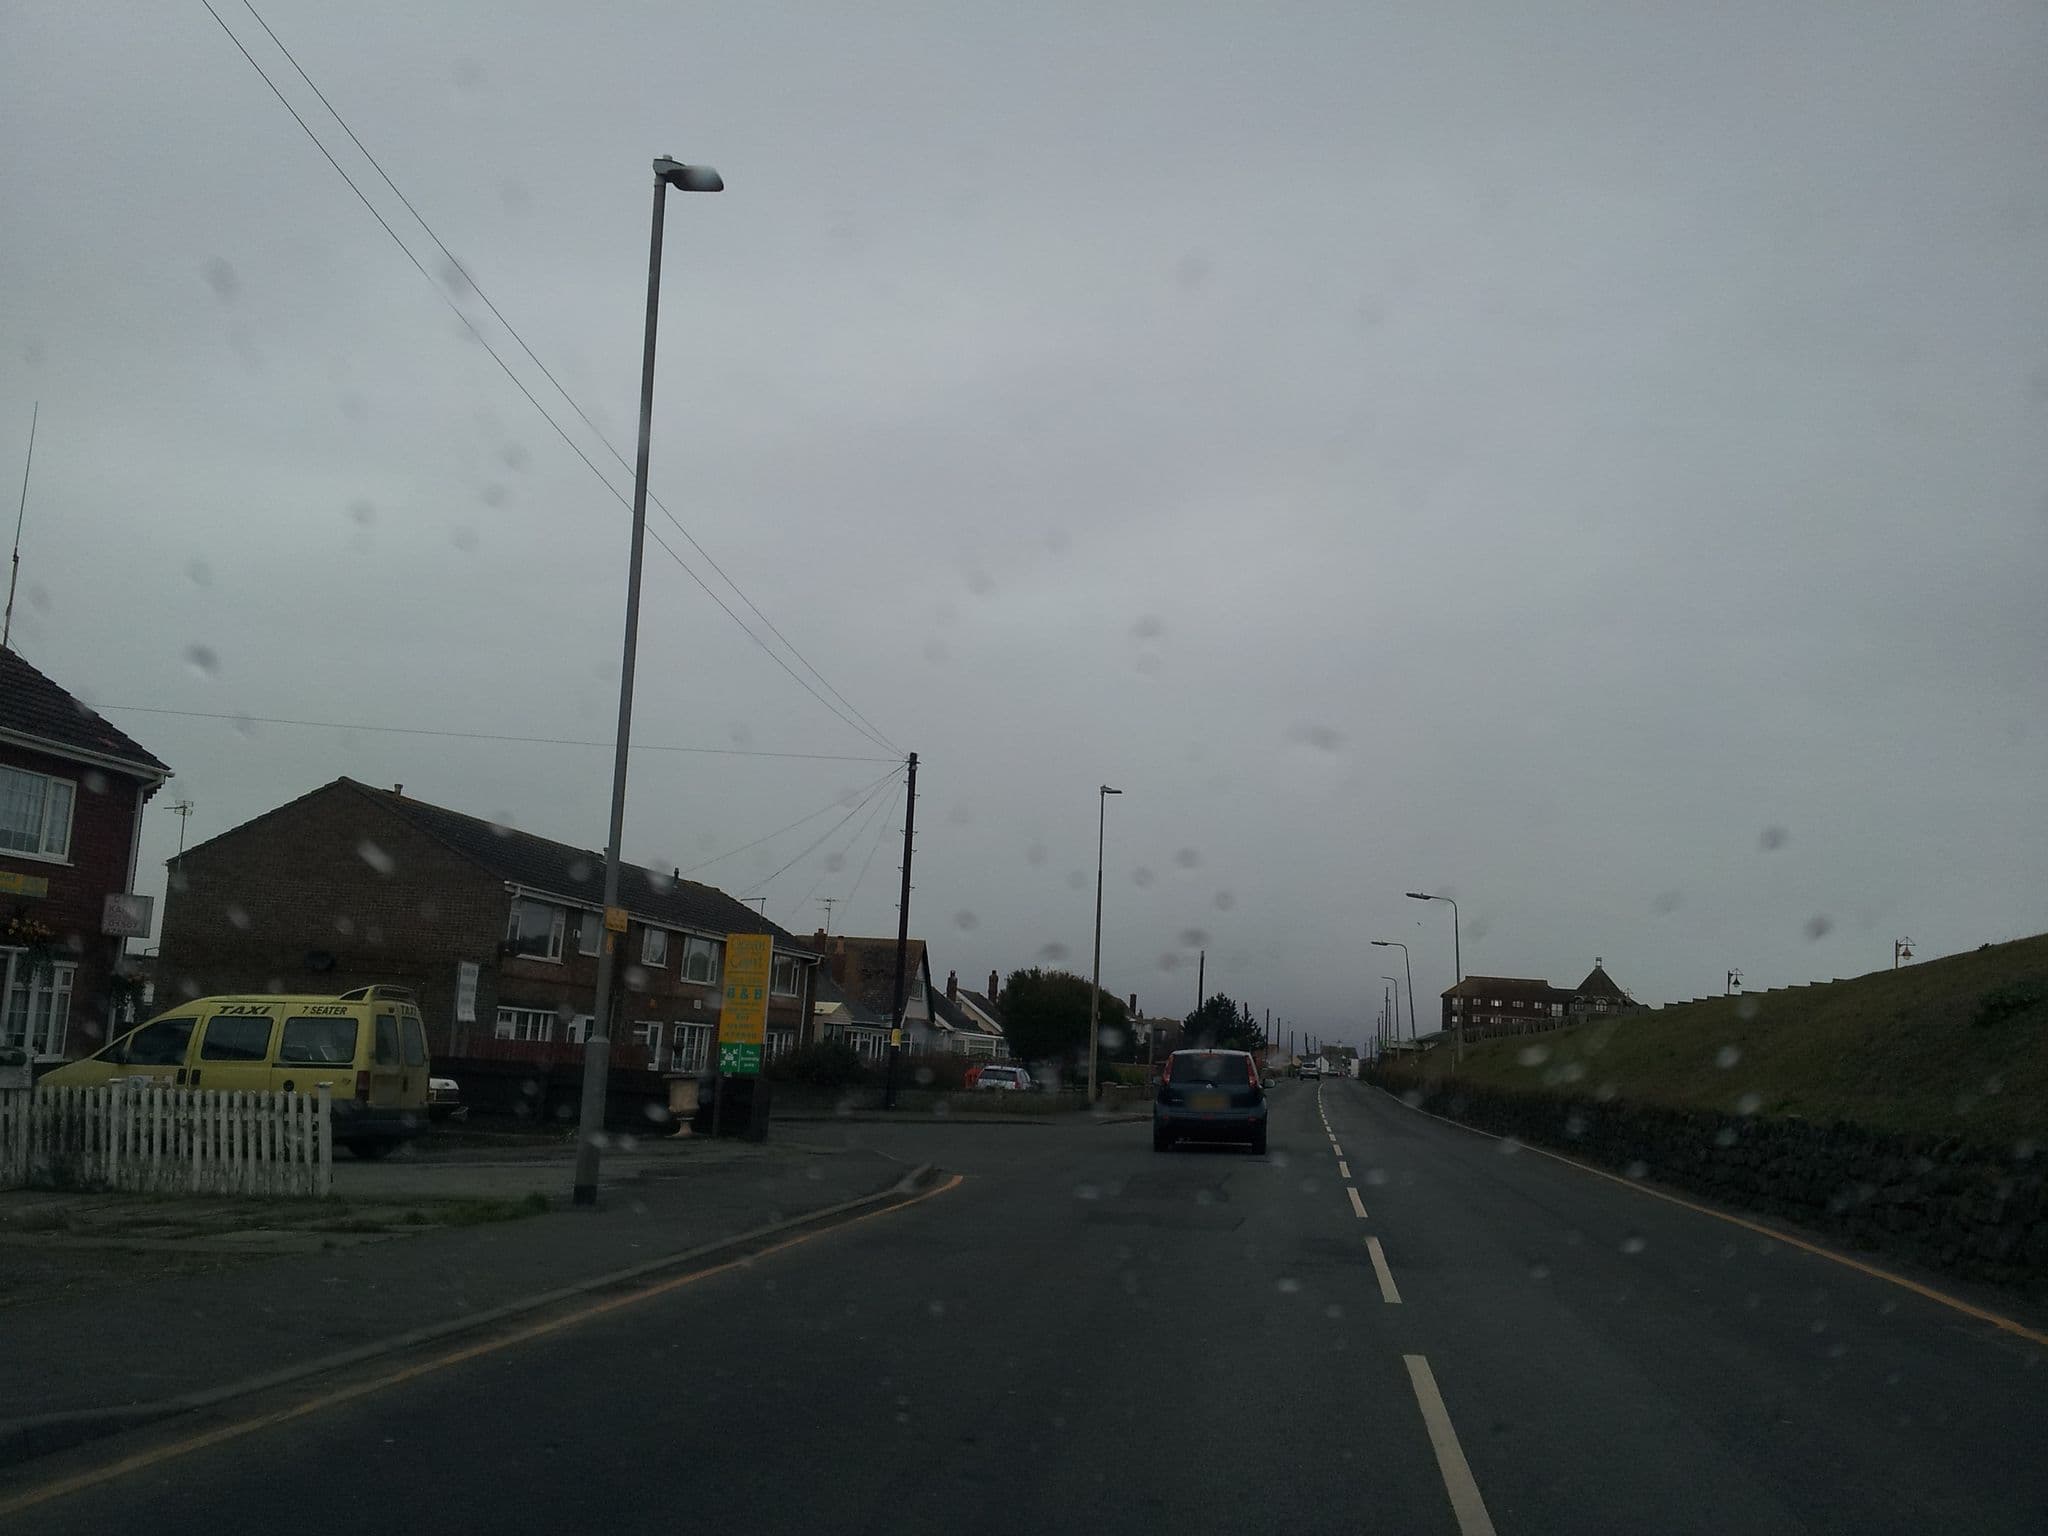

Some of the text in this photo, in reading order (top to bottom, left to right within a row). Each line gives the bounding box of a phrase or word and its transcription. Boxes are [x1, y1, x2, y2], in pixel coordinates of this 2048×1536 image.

[218, 1006, 271, 1015] TAXI
[302, 1005, 348, 1015] 7 SEATER
